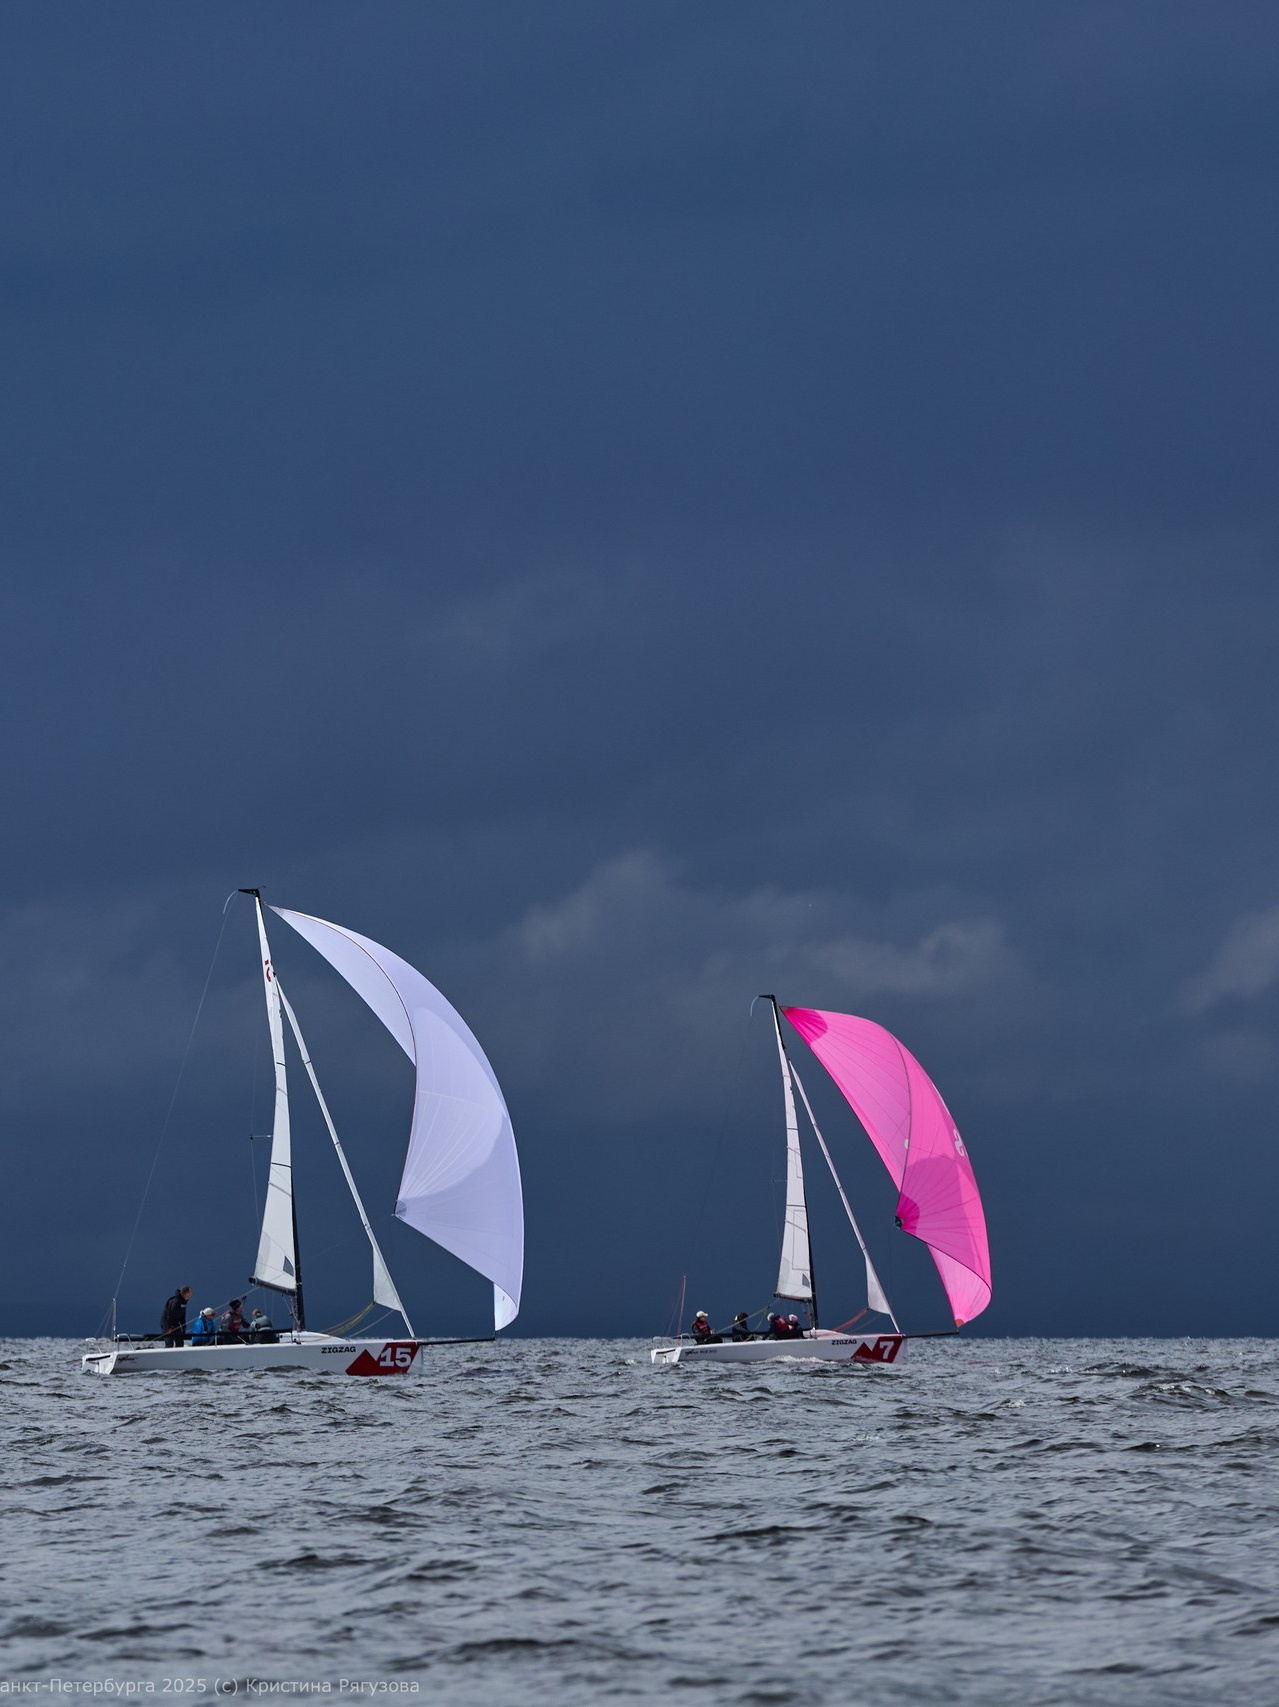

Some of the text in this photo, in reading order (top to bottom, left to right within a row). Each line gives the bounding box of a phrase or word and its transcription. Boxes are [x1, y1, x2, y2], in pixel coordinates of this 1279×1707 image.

[321, 1346, 356, 1354] ZIGZAG
[380, 1347, 412, 1368] 15
[880, 1341, 894, 1359] 7
